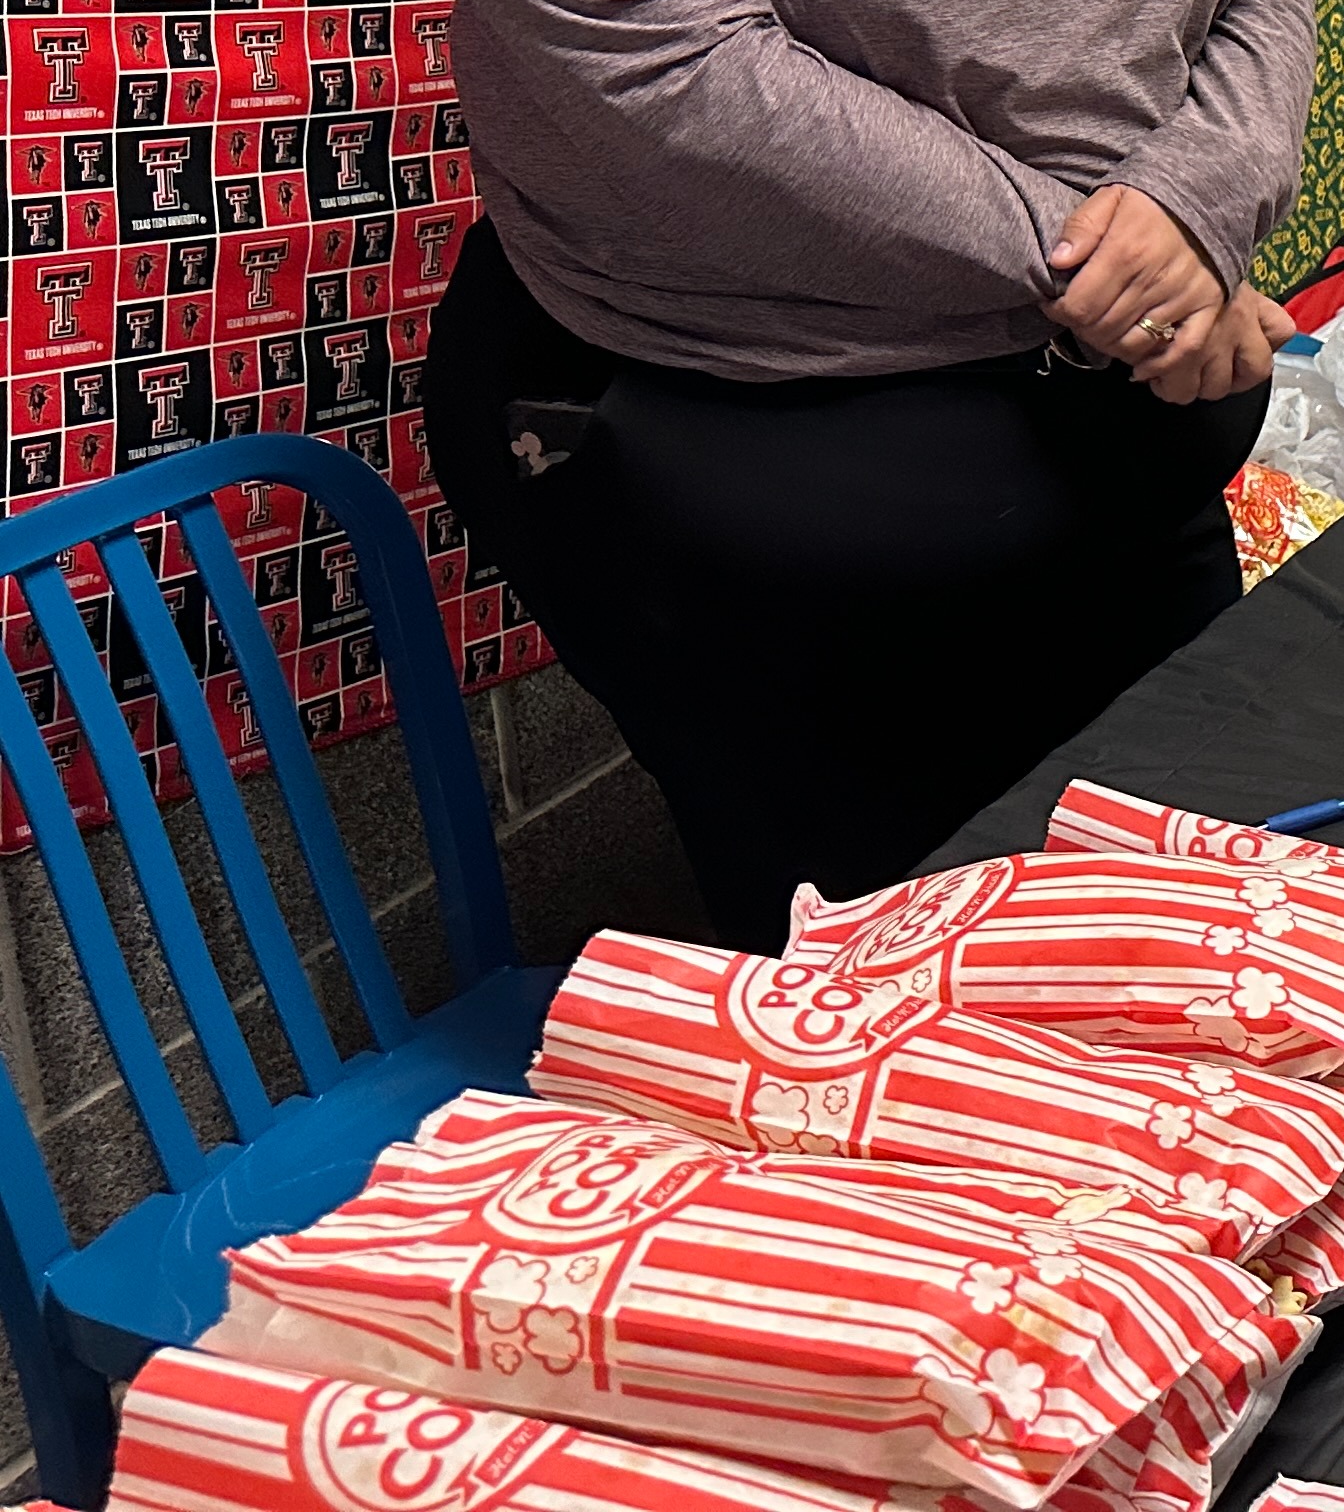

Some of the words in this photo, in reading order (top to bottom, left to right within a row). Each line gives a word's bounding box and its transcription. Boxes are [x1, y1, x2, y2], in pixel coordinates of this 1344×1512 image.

[757, 964, 816, 1008] PO
[516, 1135, 617, 1202] POP
[548, 1135, 696, 1219] CORN
[337, 1387, 424, 1449] PO
[379, 1407, 475, 1501] CO
